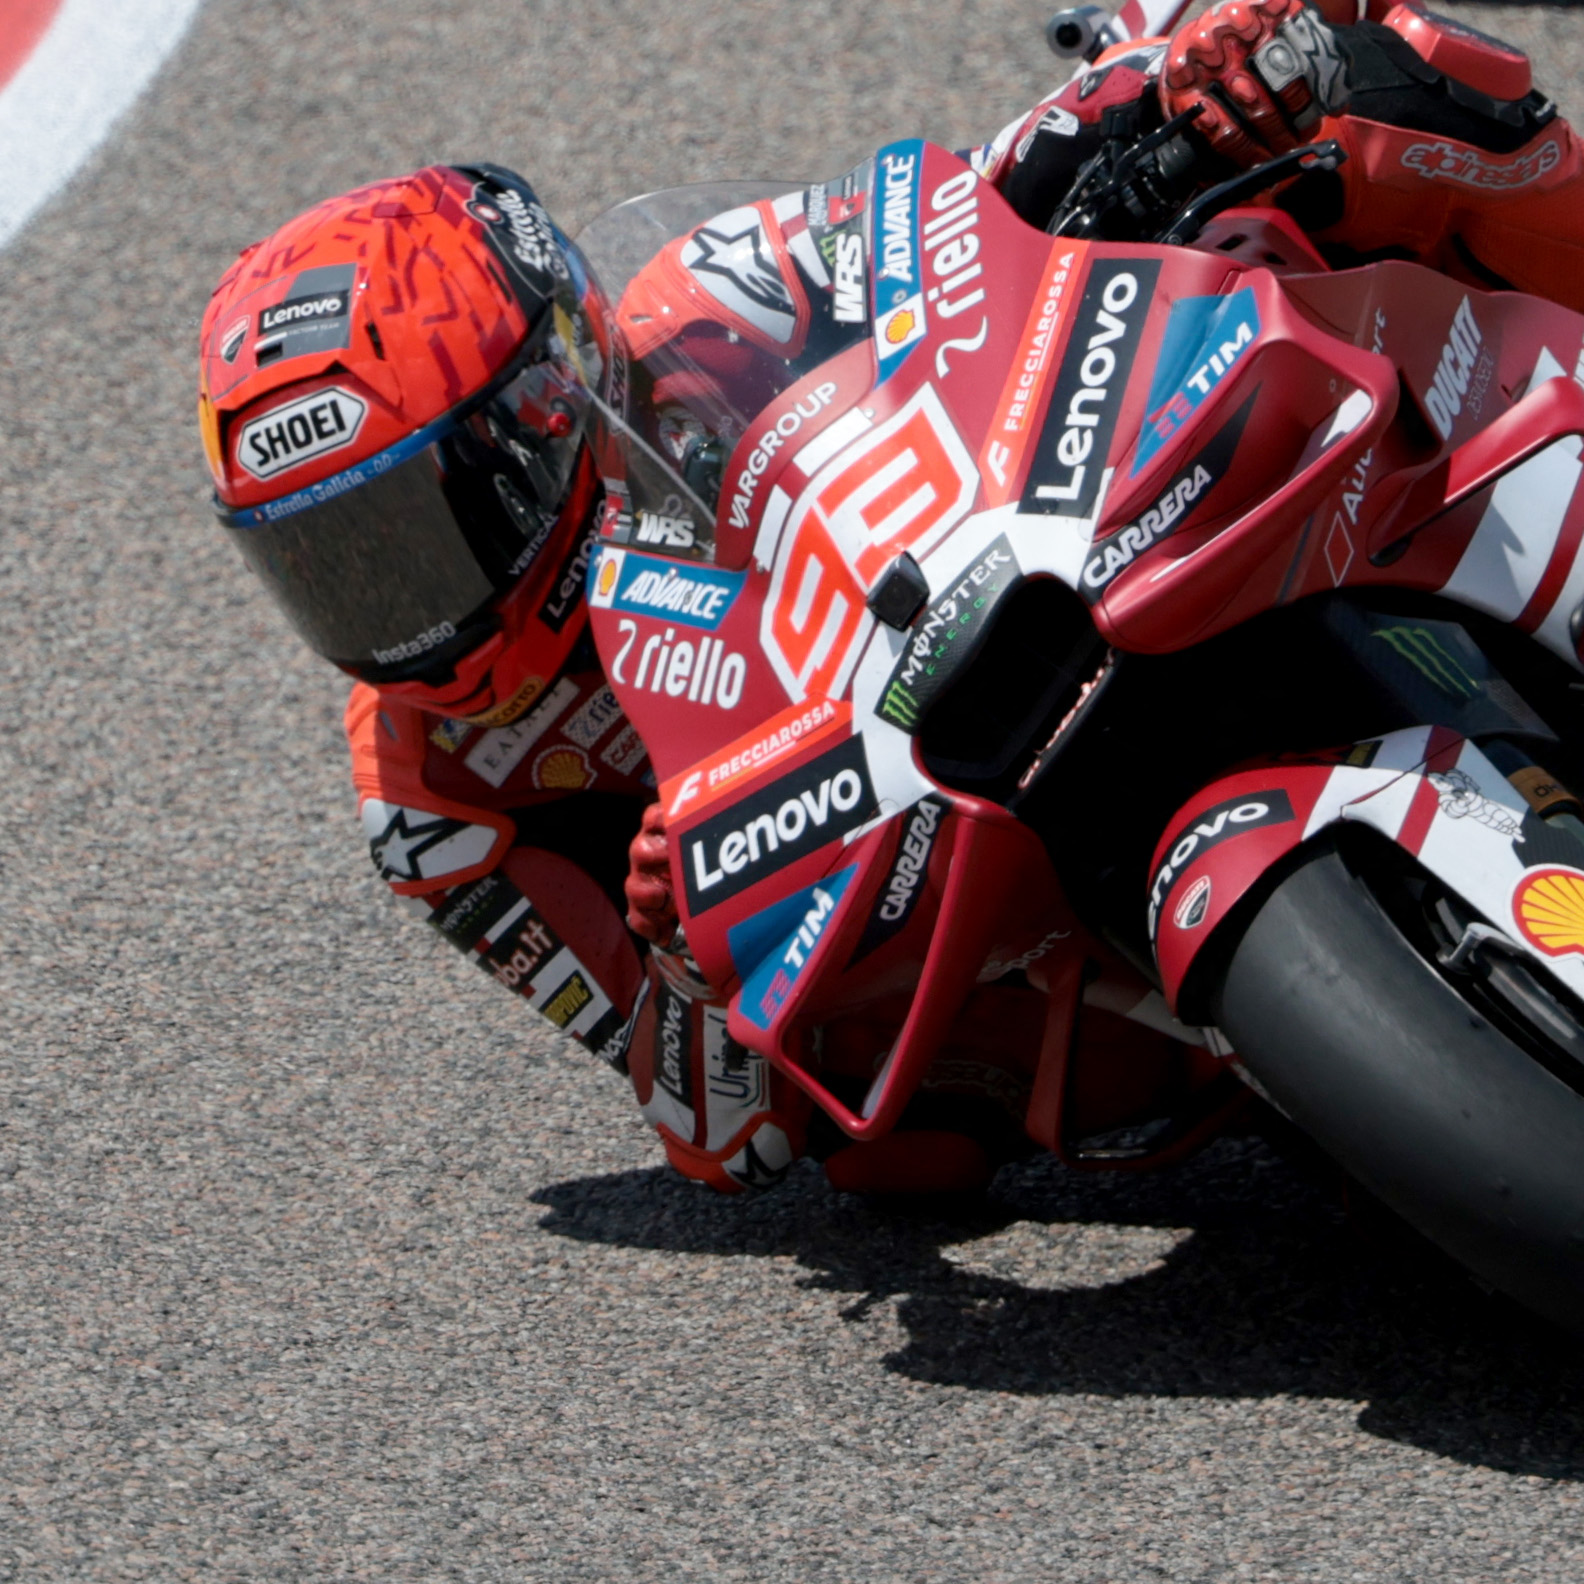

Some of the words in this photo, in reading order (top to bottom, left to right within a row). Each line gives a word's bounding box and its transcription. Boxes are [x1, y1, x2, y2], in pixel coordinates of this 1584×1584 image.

[881, 154, 915, 283] ADVANCE
[924, 169, 988, 320] riello
[263, 297, 342, 330] Lenovo
[833, 232, 864, 325] WRS
[1004, 252, 1076, 432] FRECCIAROSSA
[1035, 272, 1138, 503] Lenovo
[1187, 321, 1255, 394] TIM
[1424, 294, 1483, 442] DUCATI
[248, 398, 348, 468] SHOEI
[729, 381, 838, 530] VARGROUP
[264, 491, 314, 520] Estrella
[312, 469, 365, 503] Galicia
[636, 512, 696, 549] WRS
[764, 391, 974, 702] 93
[1082, 464, 1213, 589] CARRERA
[372, 620, 457, 665] Insta360
[620, 568, 730, 620] ADVANCE
[901, 548, 1013, 686] MONSTER
[633, 627, 747, 710] riello
[707, 700, 835, 788] FRECCIAROSSA
[691, 768, 862, 893] Lenovo
[879, 800, 942, 922] CARRERA
[1146, 801, 1270, 964] enovo
[782, 888, 836, 970] TIM
[659, 994, 684, 1097] Lenovo
